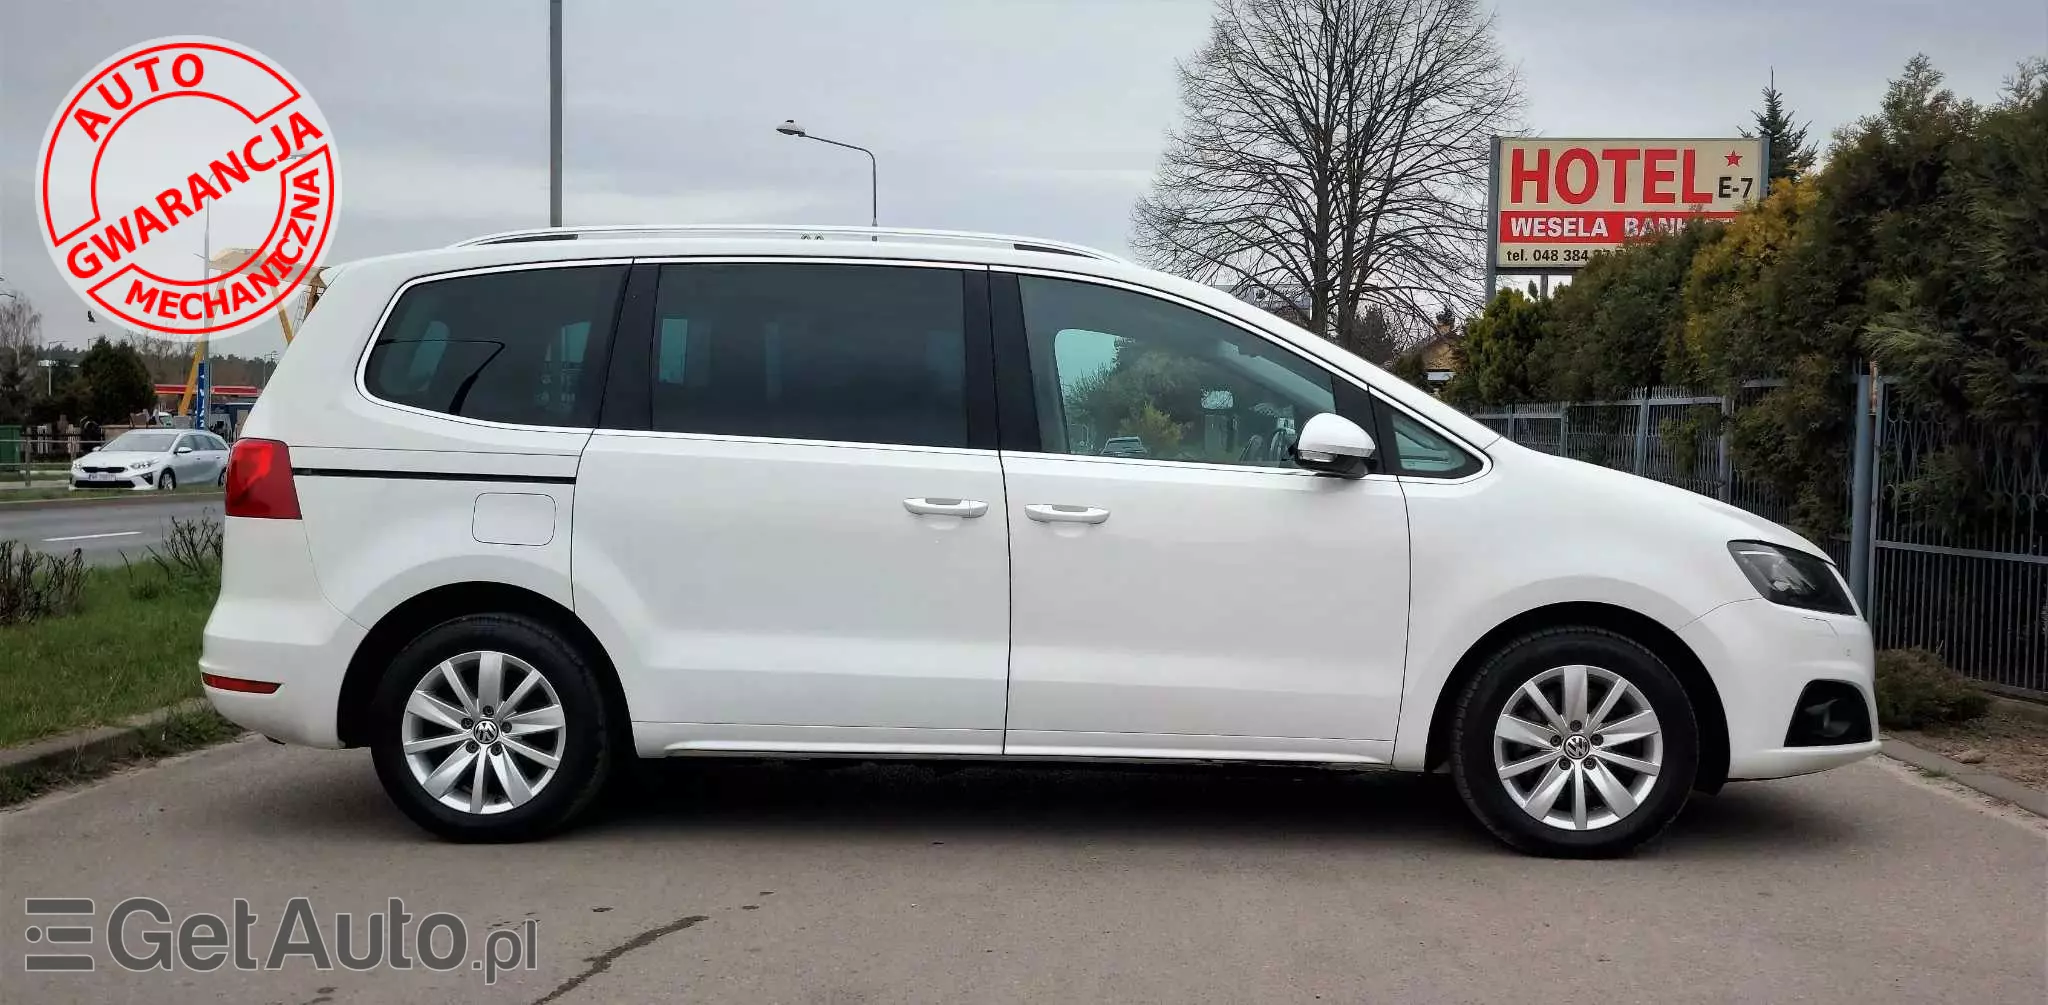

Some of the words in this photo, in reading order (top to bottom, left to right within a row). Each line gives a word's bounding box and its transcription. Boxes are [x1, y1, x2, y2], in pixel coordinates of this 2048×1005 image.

[1510, 148, 1713, 204] HOTEL
[1718, 177, 1753, 199] E-7
[1510, 217, 1609, 237] WESELA
[1506, 249, 1528, 261] tel.
[1533, 249, 1559, 261] 048
[1563, 249, 1588, 261] 384
